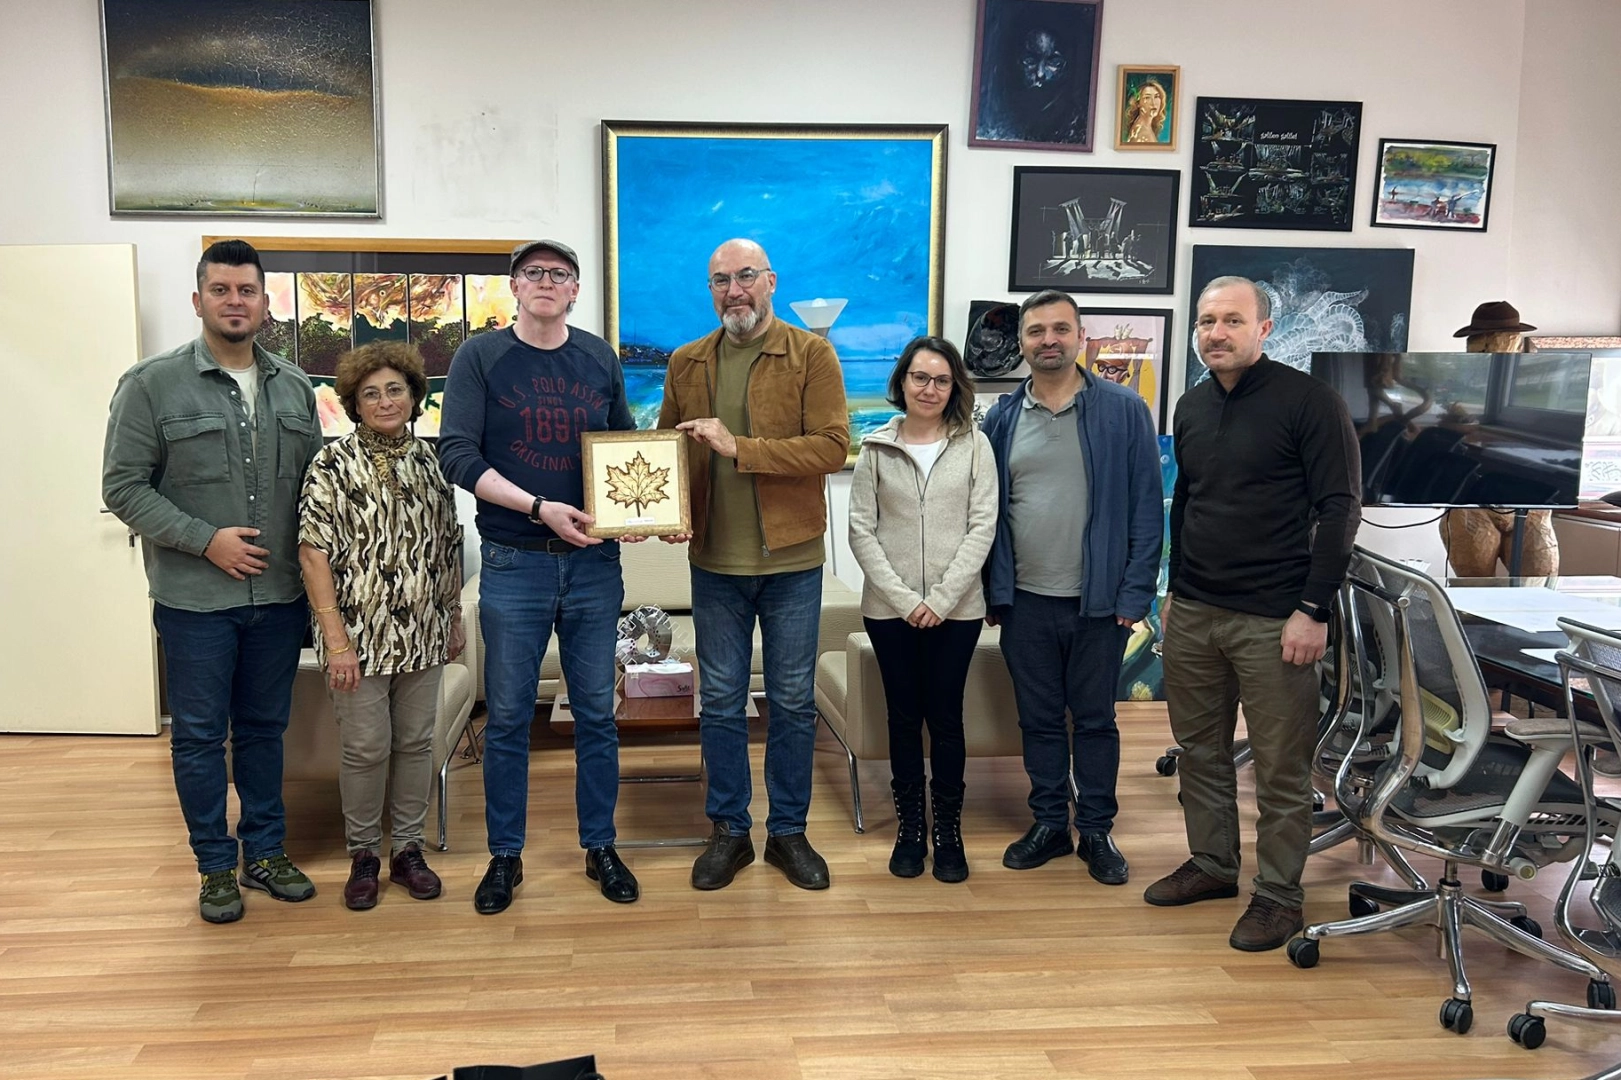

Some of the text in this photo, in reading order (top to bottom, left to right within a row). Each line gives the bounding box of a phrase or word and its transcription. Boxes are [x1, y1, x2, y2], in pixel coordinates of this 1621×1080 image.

[498, 385, 531, 409] U.S.
[532, 377, 566, 394] POLO
[519, 406, 588, 443] 1890
[510, 440, 575, 471] ORIGINAL
